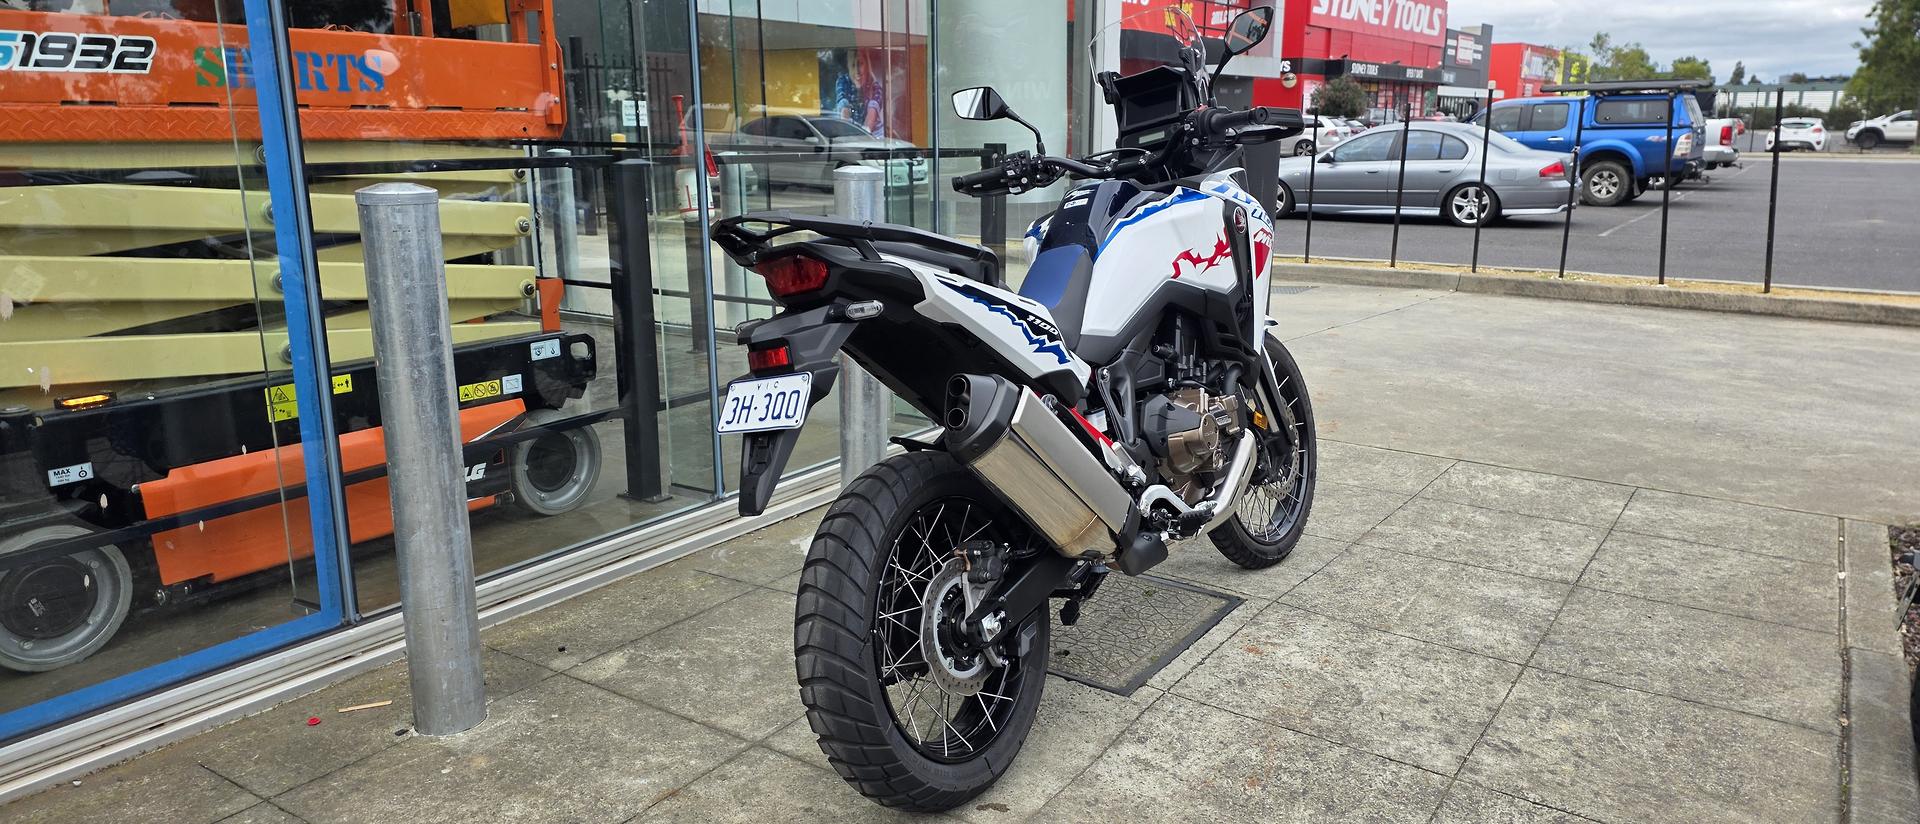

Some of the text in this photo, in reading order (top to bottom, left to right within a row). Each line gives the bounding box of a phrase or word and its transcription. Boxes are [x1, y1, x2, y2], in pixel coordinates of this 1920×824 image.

[1393, 0, 1443, 36] TOOLS
[193, 47, 386, 93] SHRTS
[1026, 314, 1059, 336] 1100
[757, 380, 779, 390] VIC
[53, 468, 71, 477] MAX
